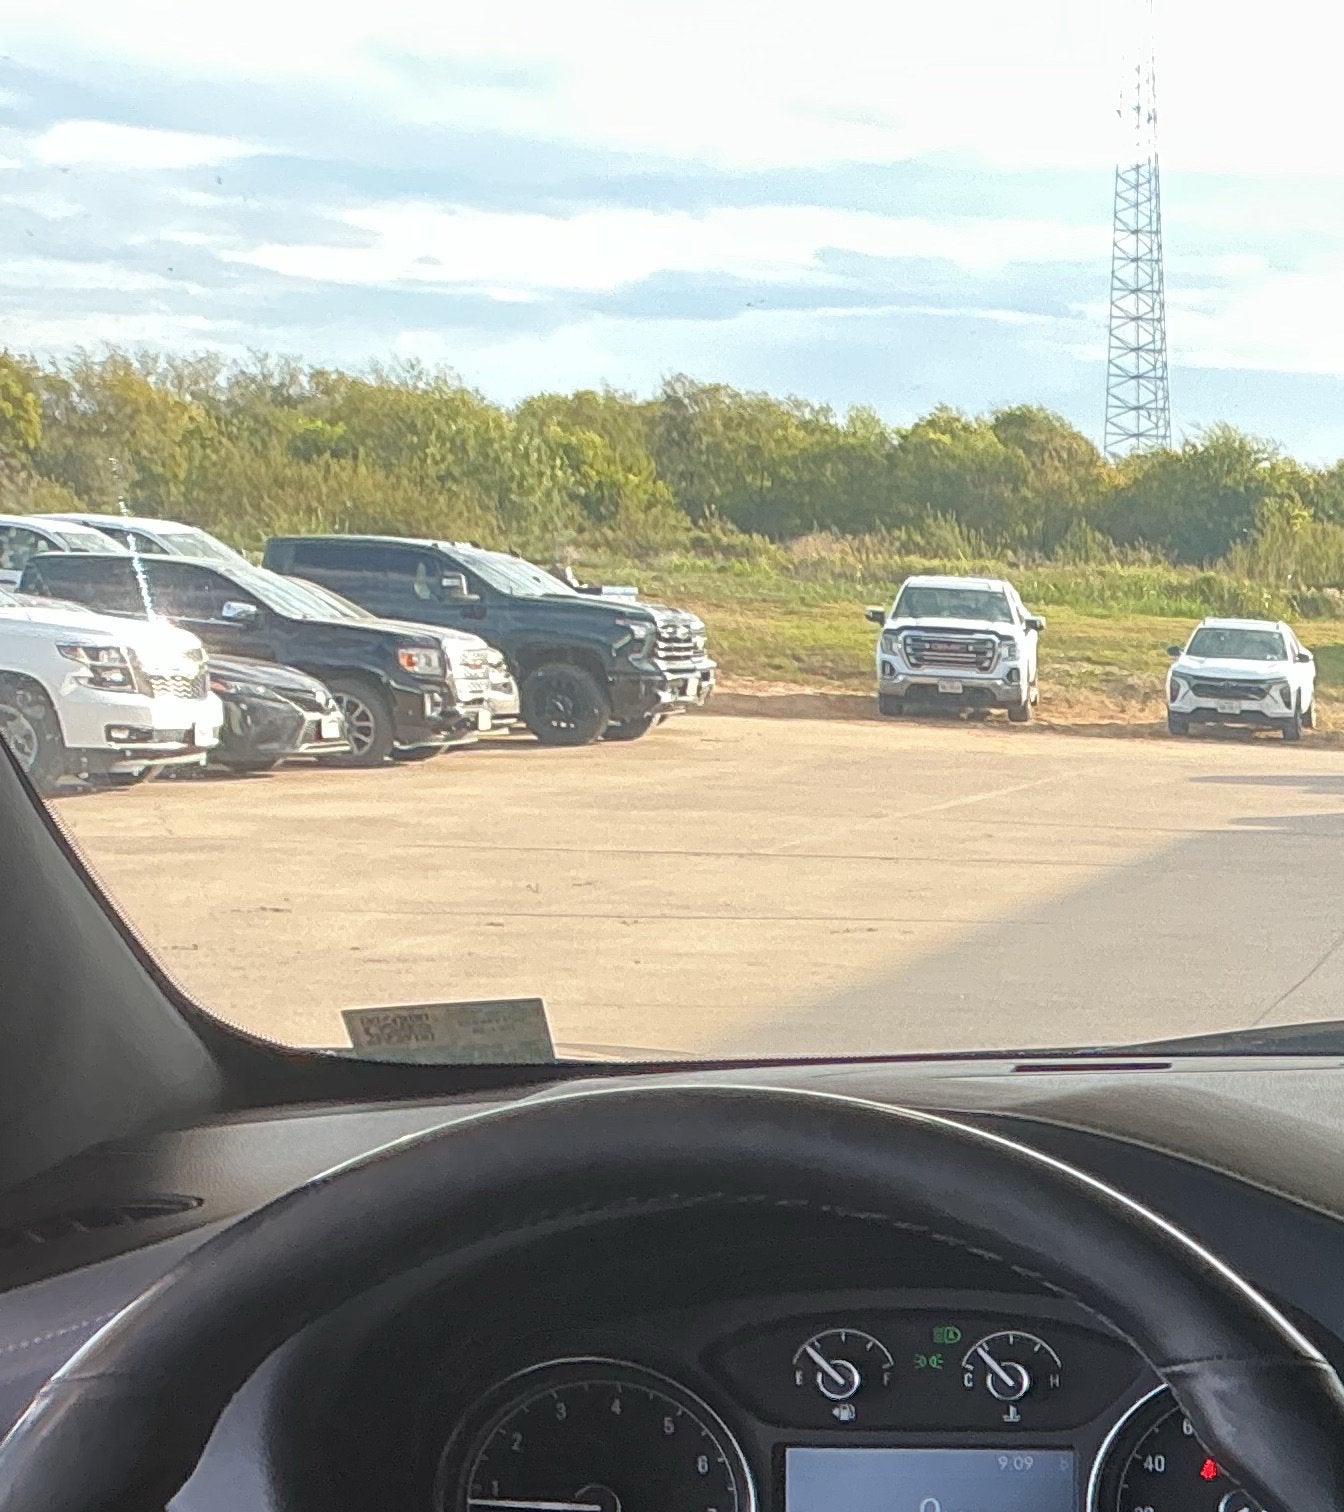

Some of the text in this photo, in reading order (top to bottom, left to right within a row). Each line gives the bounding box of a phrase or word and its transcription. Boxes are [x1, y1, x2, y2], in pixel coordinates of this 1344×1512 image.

[796, 1371, 803, 1385] E
[964, 1373, 973, 1387] C
[1050, 1373, 1060, 1387] H
[556, 1402, 566, 1420] 3
[611, 1399, 621, 1415] 4
[664, 1417, 674, 1434] 5
[511, 1432, 522, 1450] 2
[697, 1455, 708, 1474] 6
[998, 1456, 1034, 1470] 9:09
[1143, 1455, 1165, 1472] 40
